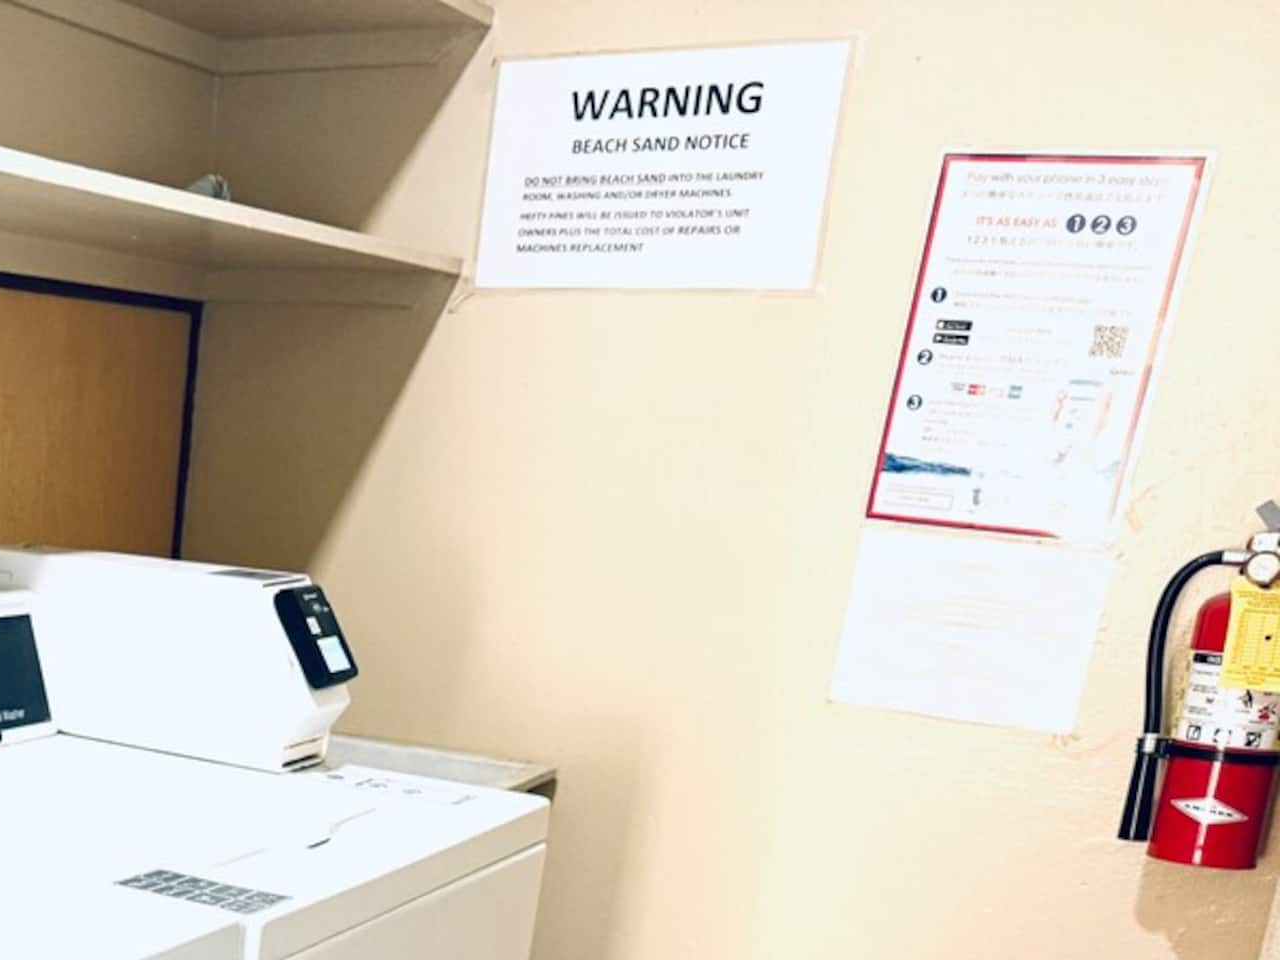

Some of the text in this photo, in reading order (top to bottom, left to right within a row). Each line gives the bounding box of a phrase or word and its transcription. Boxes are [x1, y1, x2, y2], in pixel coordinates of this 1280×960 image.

[572, 81, 765, 121] WARNING
[572, 132, 751, 154] BEACH SAND NOTICE
[524, 170, 764, 187] DO NOT BRING BEACH SAND INTO THE LAUNDRY
[991, 172, 1015, 183] with
[1017, 175, 1041, 185] your
[1043, 174, 1083, 185] phone
[556, 191, 601, 200] WASHING
[645, 189, 676, 199] DRYER
[650, 209, 663, 218] TO
[996, 216, 1010, 227] AS
[1013, 216, 1041, 228] EASY
[1042, 217, 1057, 228] AS
[677, 225, 722, 235] REPAIRS
[724, 224, 741, 235] OR
[516, 242, 644, 253] MACHINES REPLACEMENT
